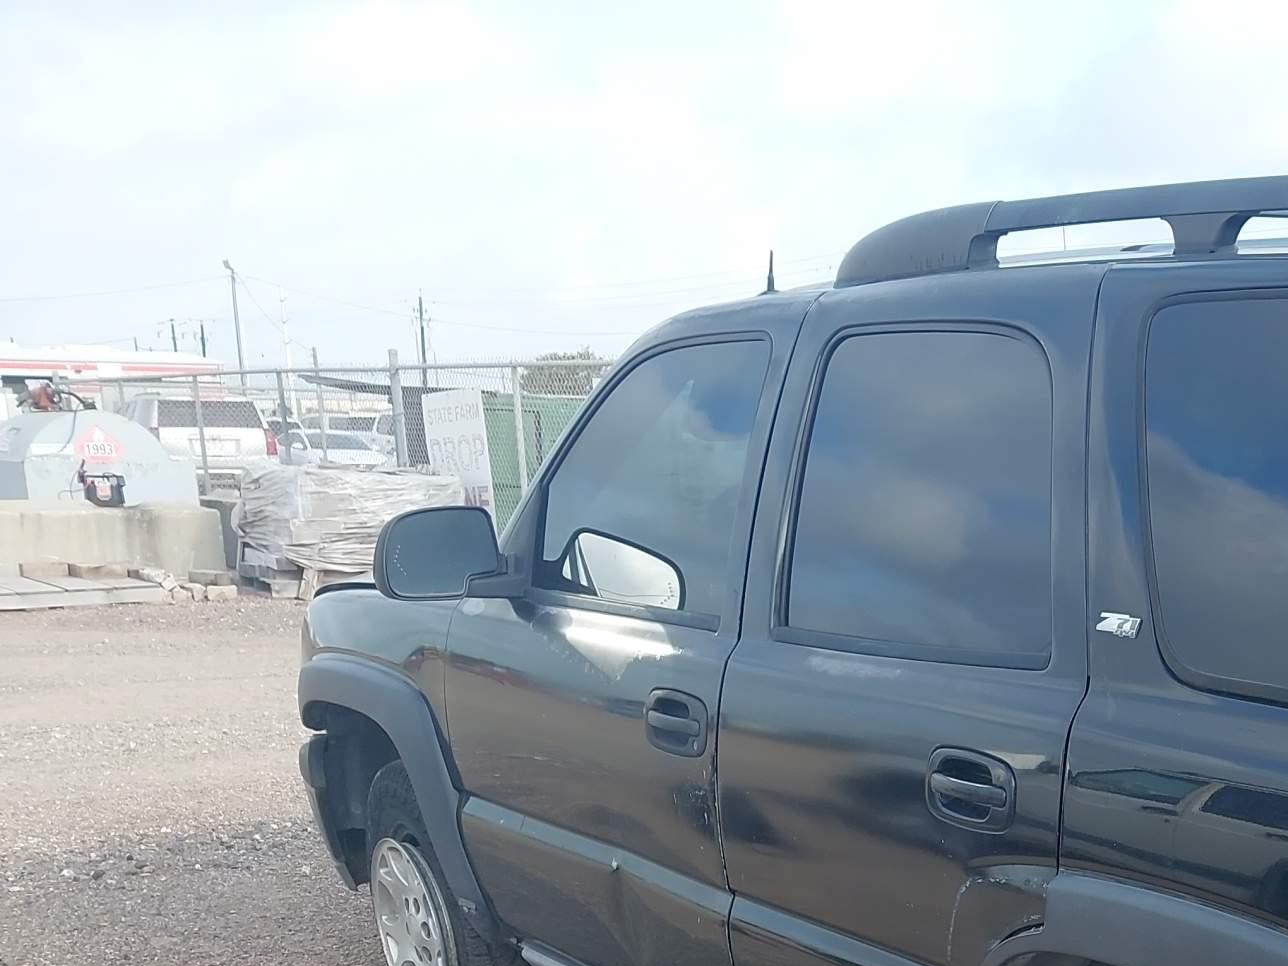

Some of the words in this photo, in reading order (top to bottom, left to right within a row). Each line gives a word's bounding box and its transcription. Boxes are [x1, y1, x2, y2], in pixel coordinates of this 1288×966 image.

[427, 407, 453, 425] STATE
[454, 402, 481, 421] FARM
[86, 443, 113, 455] 1993
